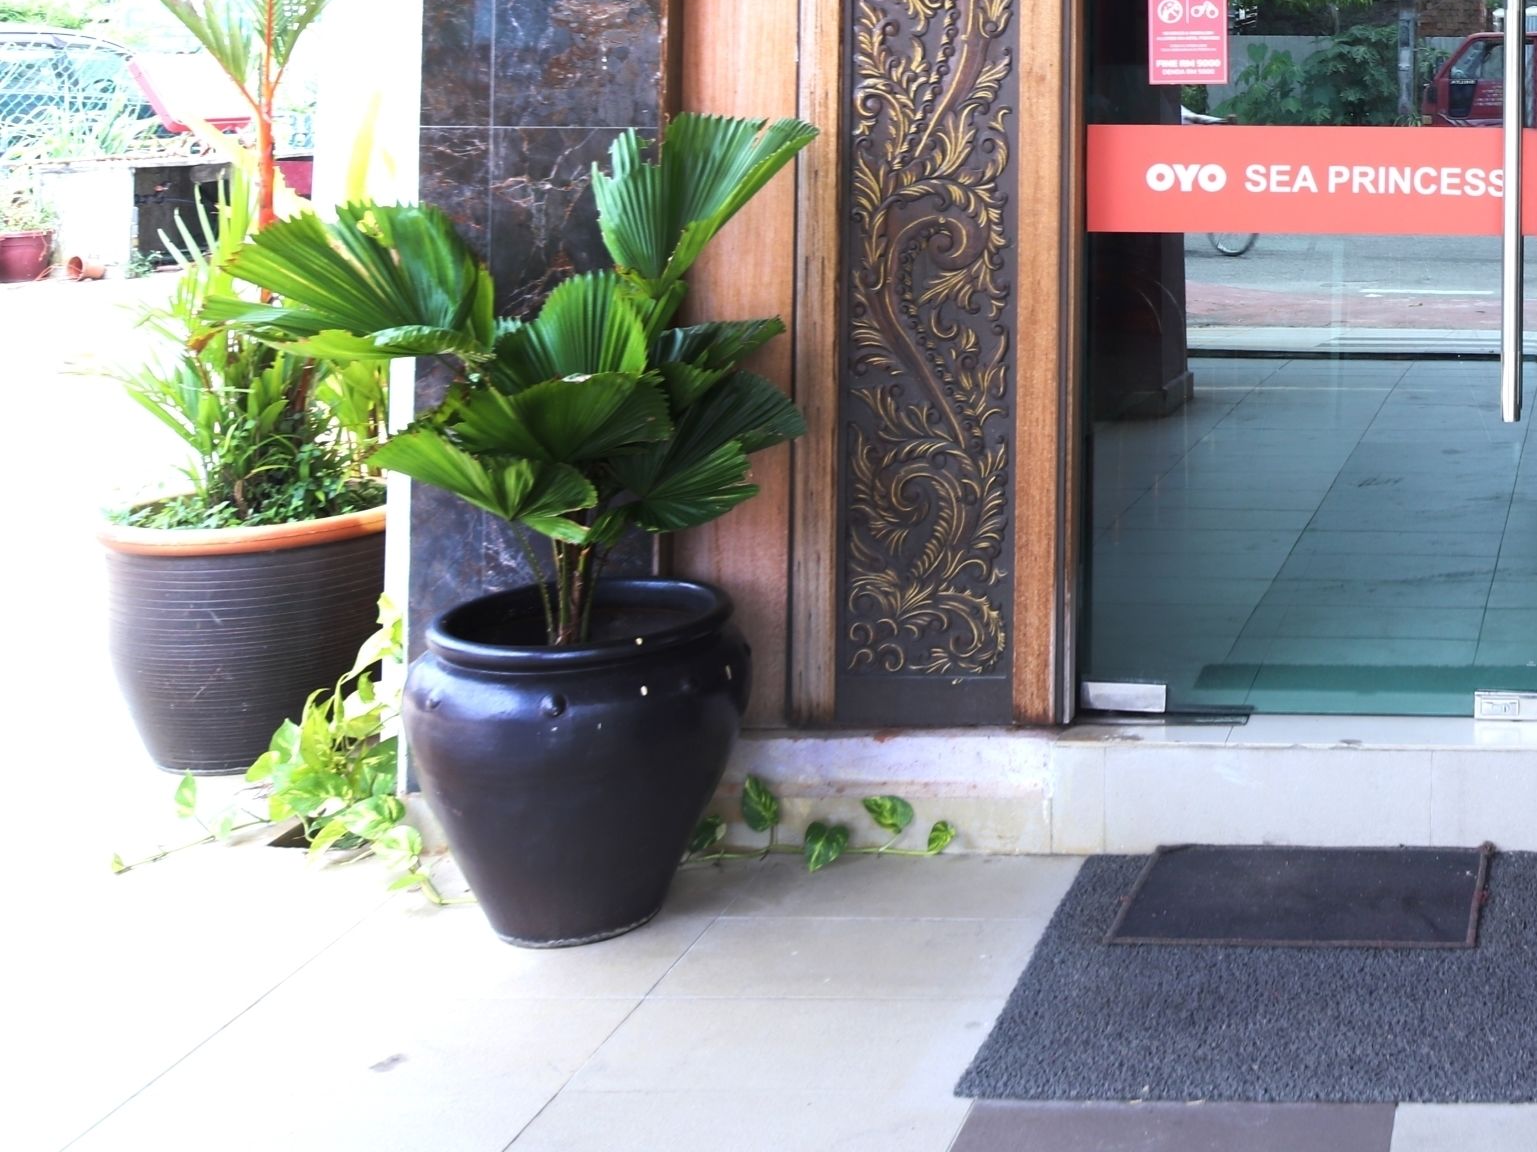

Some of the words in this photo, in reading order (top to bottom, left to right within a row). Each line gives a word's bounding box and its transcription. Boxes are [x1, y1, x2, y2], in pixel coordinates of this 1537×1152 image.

[1145, 163, 1228, 192] OYO
[1244, 164, 1318, 193] SEA
[1328, 165, 1505, 197] PRINCESS
